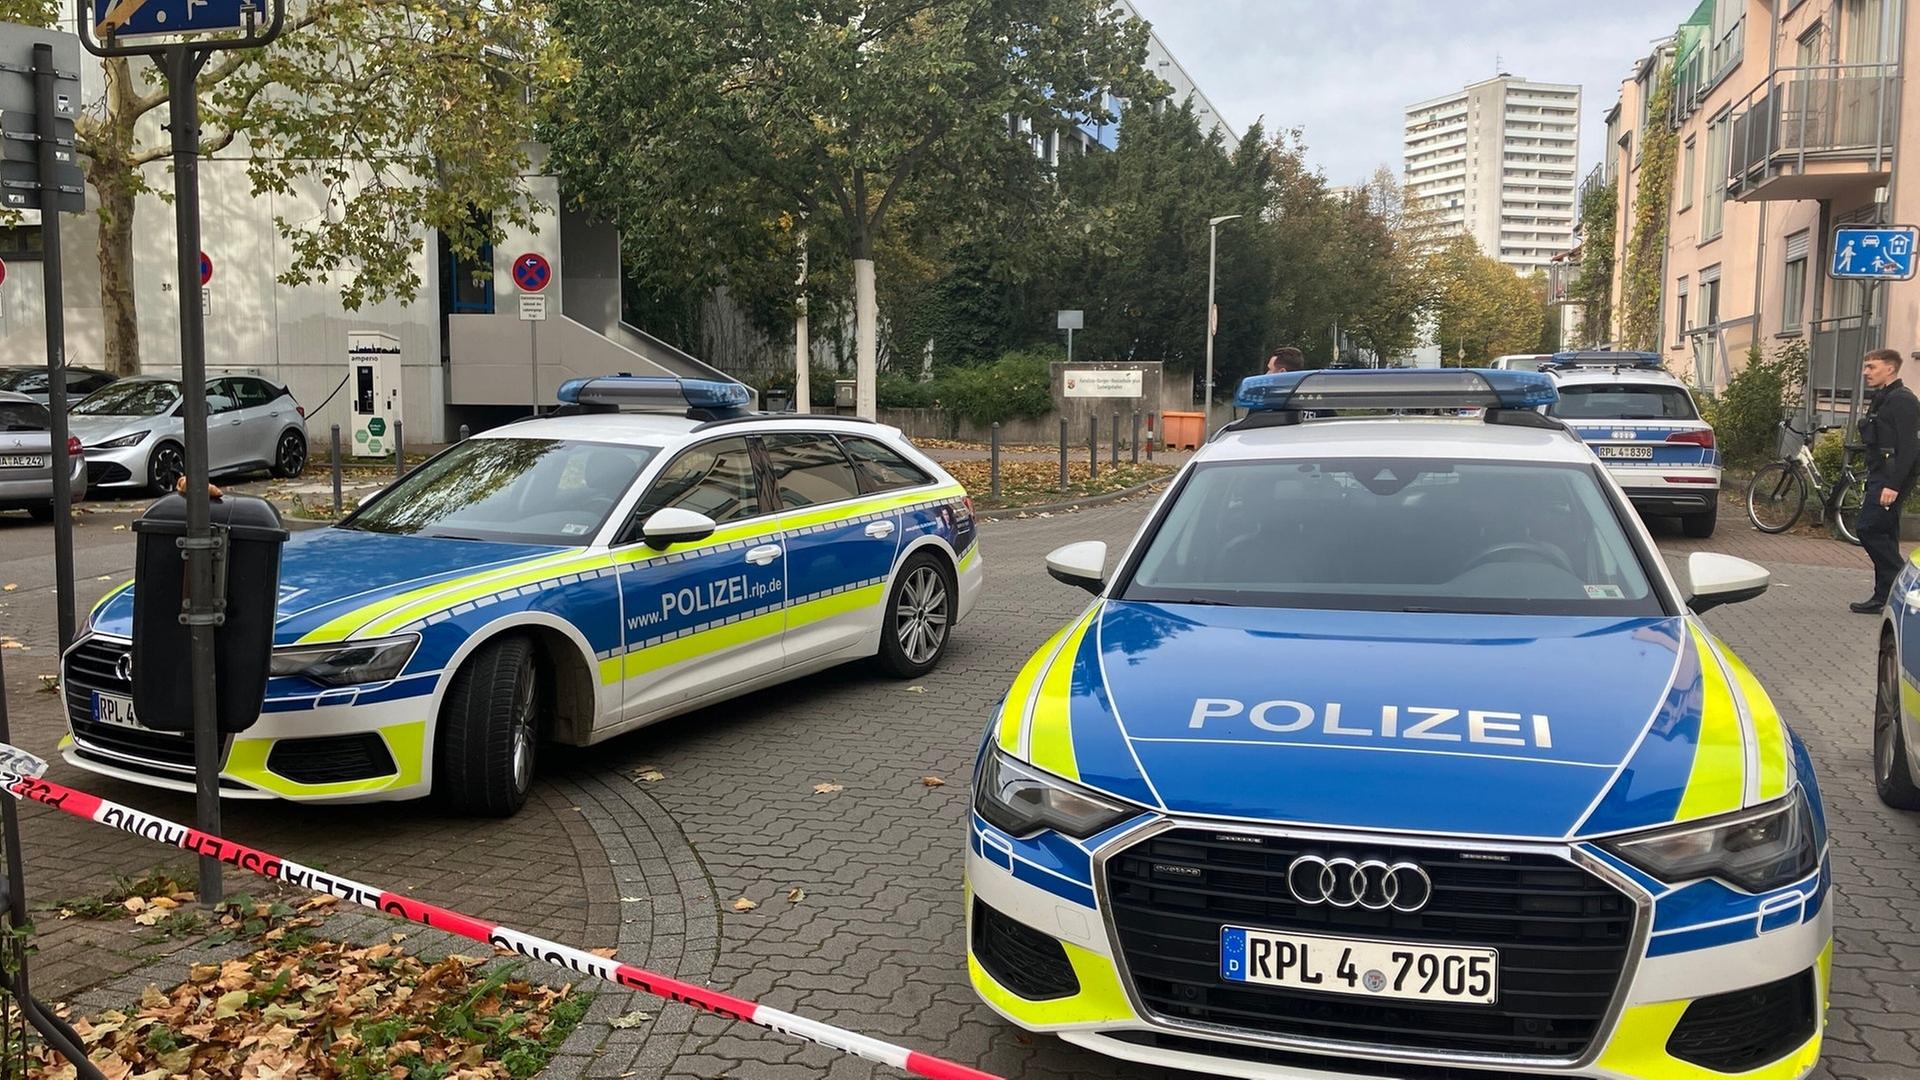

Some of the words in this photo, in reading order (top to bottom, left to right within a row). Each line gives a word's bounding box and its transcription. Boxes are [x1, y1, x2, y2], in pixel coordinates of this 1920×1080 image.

[1600, 447, 1617, 457] RPL
[1618, 447, 1624, 457] 4
[1630, 447, 1652, 457] 8398
[627, 574, 783, 631] www.POLIZEI.rlp.de
[100, 697, 123, 723] RPL
[127, 703, 134, 726] 4
[1188, 697, 1553, 750] POLIZEI
[1249, 937, 1322, 985] RPL
[1335, 947, 1358, 988] 4
[1391, 951, 1490, 997] 7905
